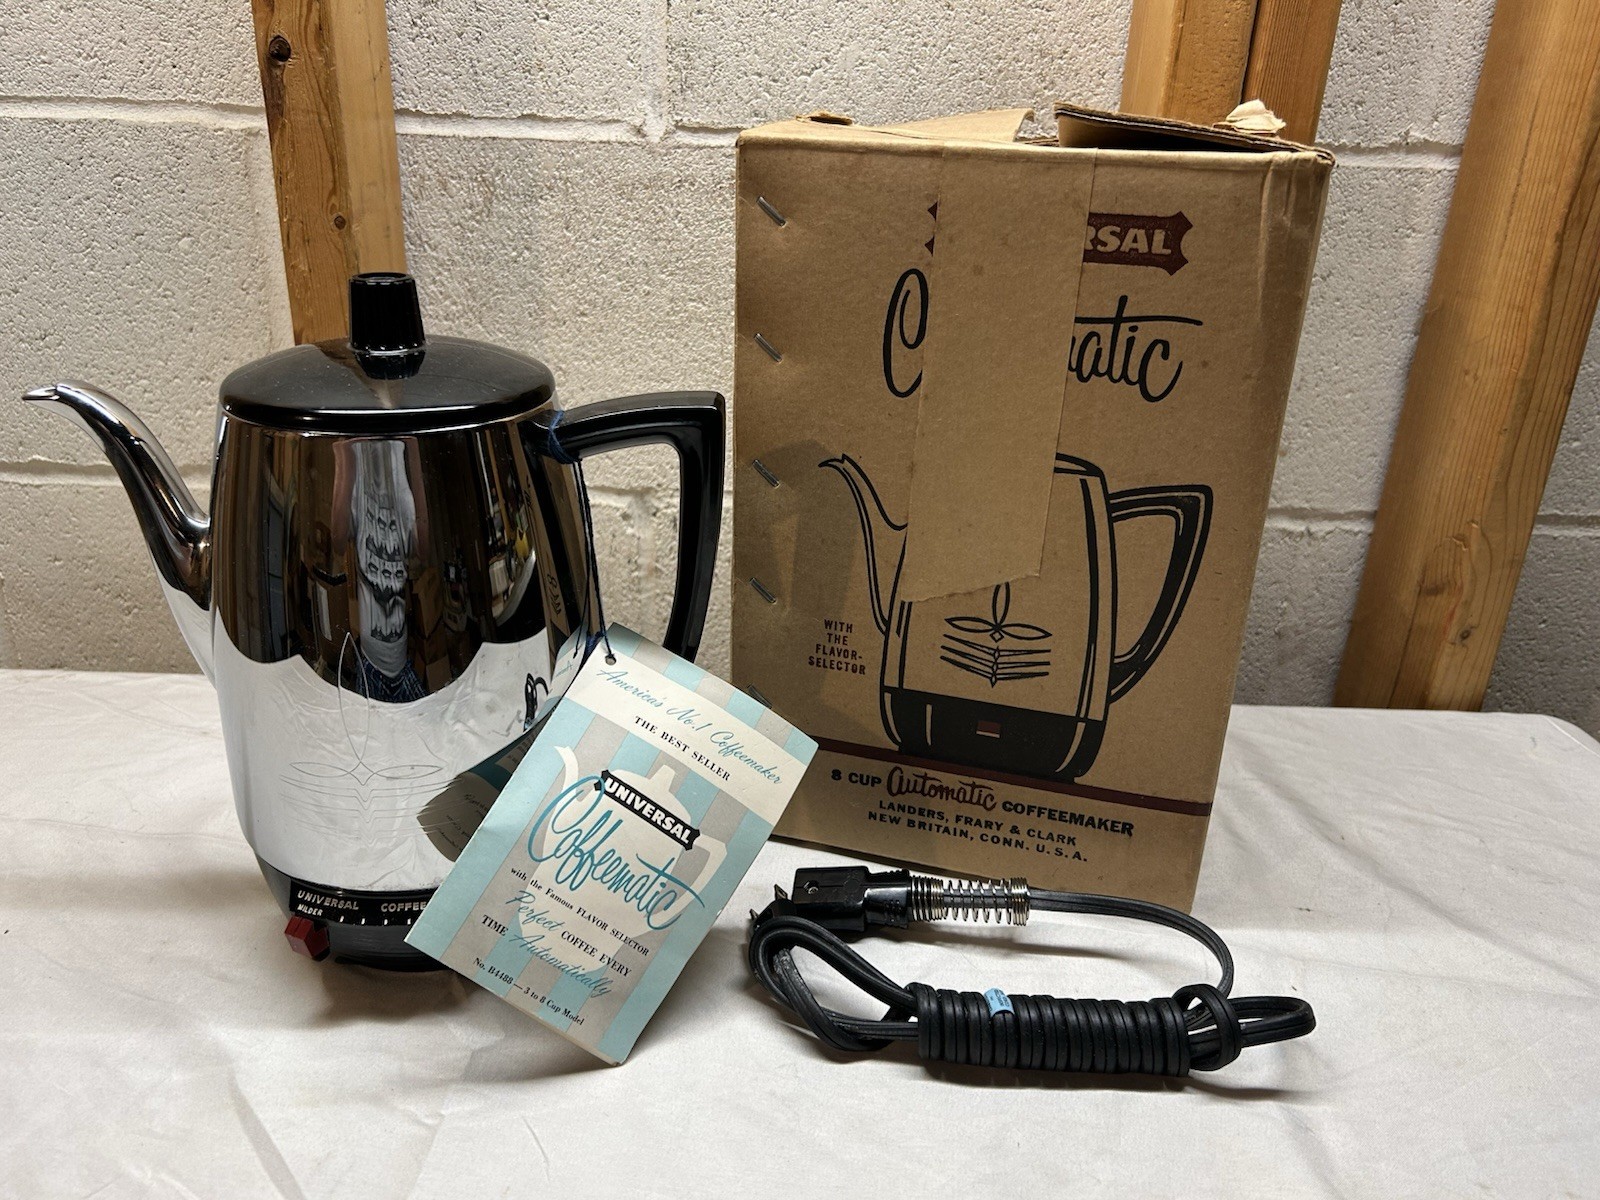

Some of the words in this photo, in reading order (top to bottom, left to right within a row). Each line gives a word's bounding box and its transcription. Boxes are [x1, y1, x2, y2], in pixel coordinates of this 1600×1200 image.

[815, 643, 863, 661] FLAVOR-
[824, 619, 853, 633] WITH
[827, 632, 849, 646] THE
[808, 655, 866, 675] SELECTOR
[596, 669, 667, 708] America's
[710, 730, 782, 785] Coffeemaker
[635, 715, 657, 735] THE
[660, 731, 690, 753] BEST
[691, 750, 731, 782] SELLER
[604, 777, 694, 845] UNIVERSAL
[831, 769, 842, 781] 8
[848, 772, 882, 787] CUP
[886, 766, 998, 811] Automatic
[1001, 801, 1134, 838] COFFEEMAKER
[868, 811, 901, 825] NEW
[906, 819, 974, 841] BRITAIN,
[979, 833, 1030, 850] CONN.
[879, 800, 949, 823] LANDERS,
[955, 815, 1004, 831] FRARY
[1009, 825, 1021, 835] &
[1026, 828, 1077, 846] CLARK
[528, 775, 706, 930] Coffeematic
[296, 904, 324, 917] MILDER
[297, 890, 360, 910] UNIVERSAL
[510, 867, 527, 881] with
[530, 879, 543, 891] the
[545, 888, 574, 910] Famous
[576, 907, 609, 931] FLAVOR
[610, 928, 650, 956] SELECTOR
[481, 914, 509, 937] TIME
[509, 933, 613, 998] Automatically
[505, 890, 565, 932] Perfect
[560, 930, 598, 958] COFFEE
[599, 953, 633, 978] EVERY
[473, 957, 486, 970] No.
[523, 986, 531, 994] 3
[530, 990, 538, 1000] to
[546, 999, 561, 1013] Cup
[562, 1008, 585, 1026] Model
